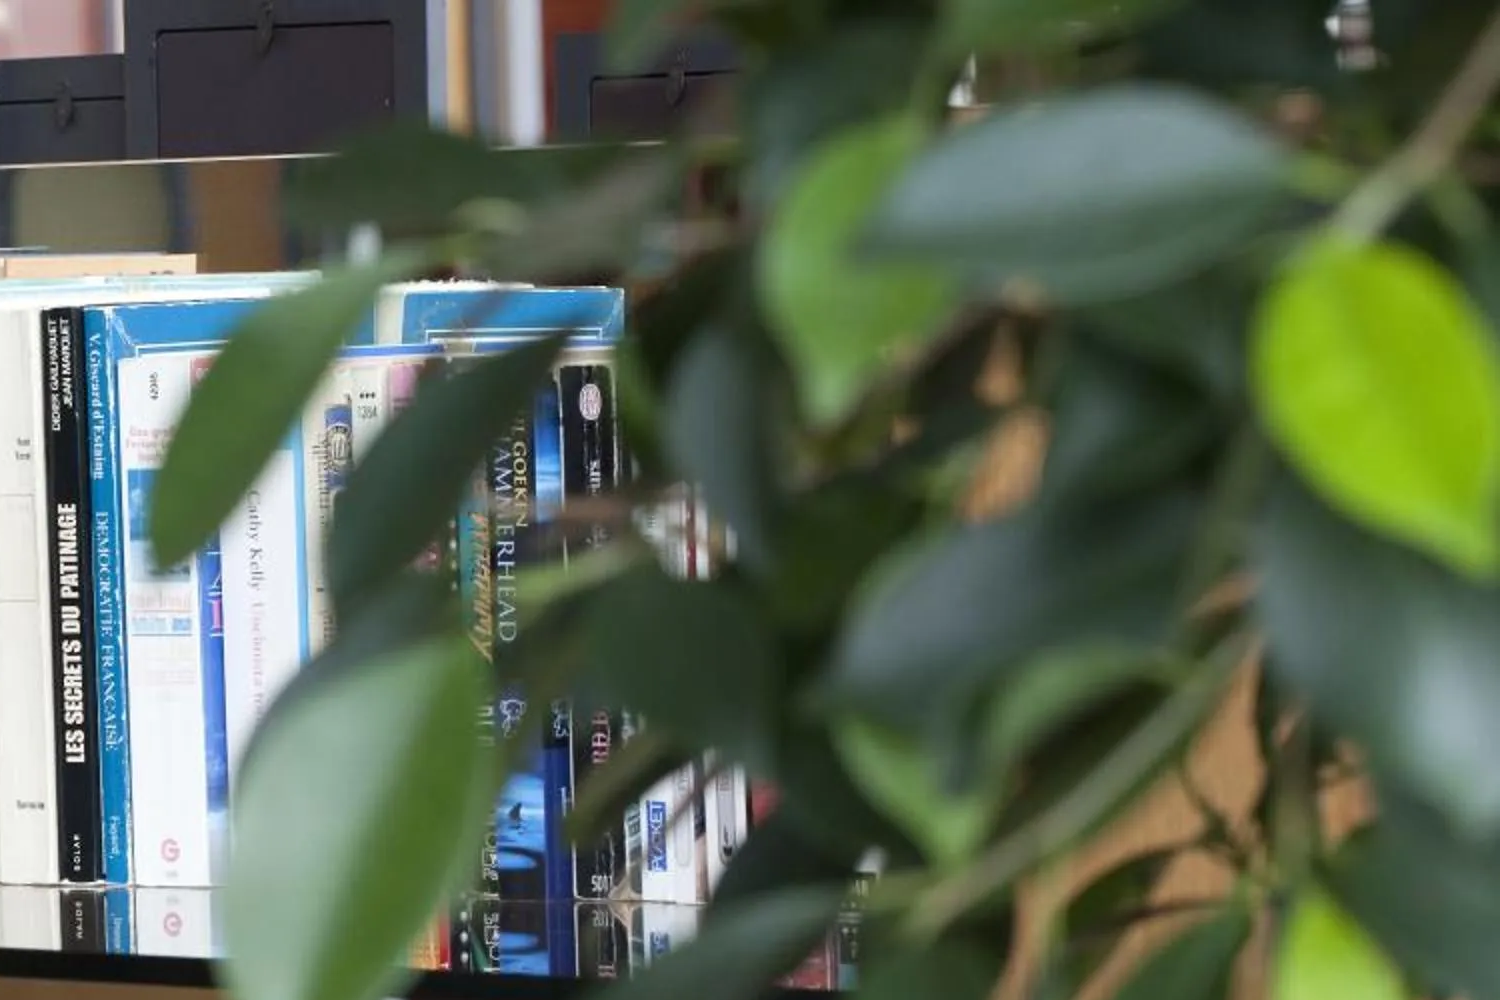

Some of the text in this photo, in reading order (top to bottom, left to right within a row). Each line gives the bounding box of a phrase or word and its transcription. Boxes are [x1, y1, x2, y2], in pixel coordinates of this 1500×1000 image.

[61, 378, 73, 408] JEAN
[90, 350, 105, 408] Giscard
[91, 411, 106, 481] d'Estaing
[246, 490, 263, 542] Cathy
[494, 437, 519, 642] AMMERHEAD
[57, 503, 79, 599] PATINAGE
[247, 548, 266, 591] Kelly
[60, 605, 81, 635] DU
[62, 639, 84, 725] SECRETS
[65, 729, 85, 763] LES
